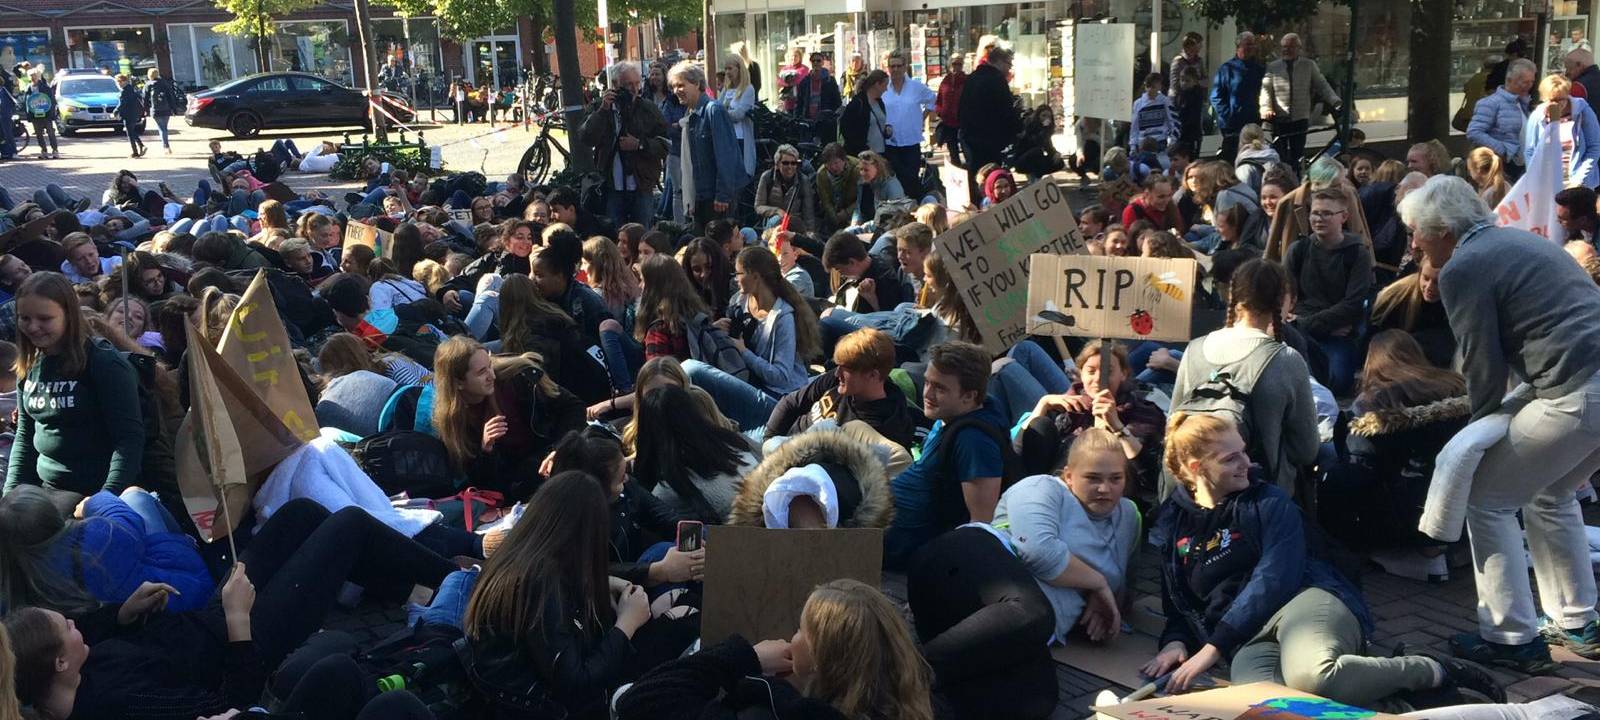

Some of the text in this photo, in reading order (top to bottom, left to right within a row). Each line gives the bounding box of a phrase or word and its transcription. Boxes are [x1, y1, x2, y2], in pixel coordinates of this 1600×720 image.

[994, 199, 1034, 233] WILL
[1034, 182, 1061, 211] GO
[960, 255, 990, 280] TO
[967, 284, 982, 307] IF
[982, 268, 1016, 298] YOU
[1018, 243, 1050, 277] KP
[1050, 229, 1083, 256] THE
[1063, 268, 1134, 311] RIP
[28, 395, 75, 410] NO ONE
